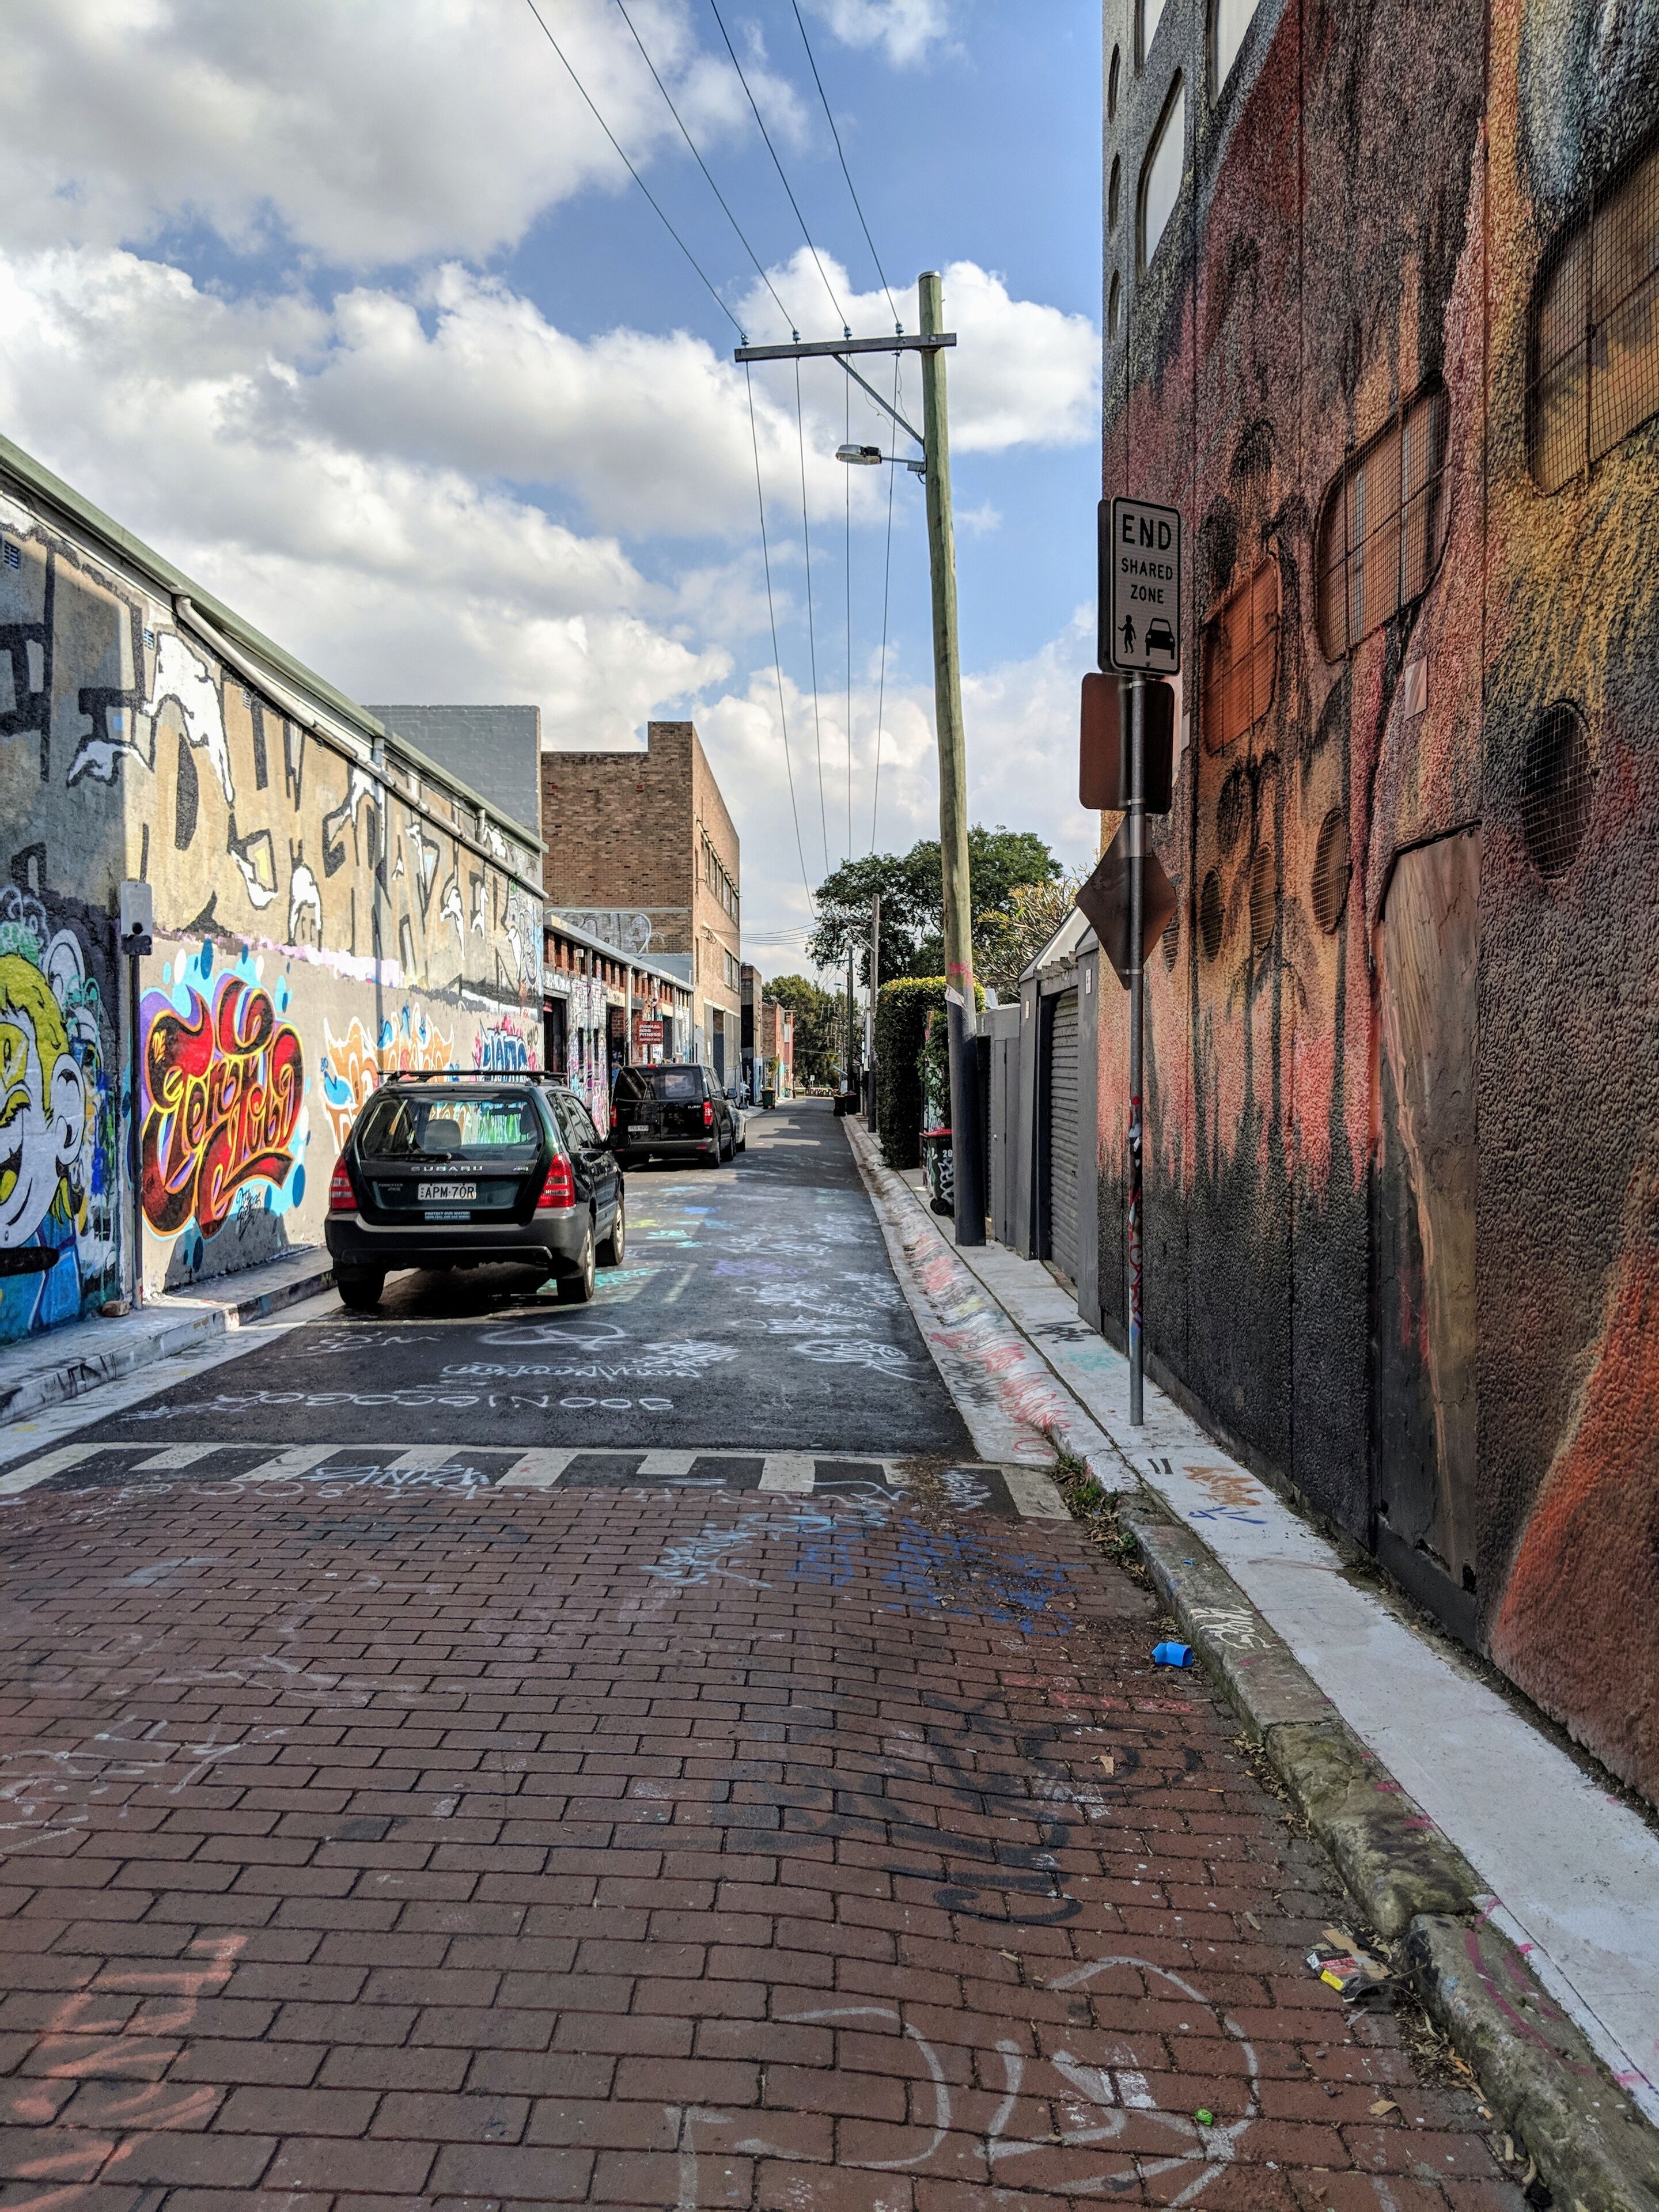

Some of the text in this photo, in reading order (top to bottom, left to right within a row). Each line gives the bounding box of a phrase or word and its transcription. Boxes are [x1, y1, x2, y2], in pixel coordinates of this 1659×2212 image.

[1123, 513, 1171, 550] END
[1121, 558, 1173, 580] SHARED
[1130, 584, 1164, 604] ZONE
